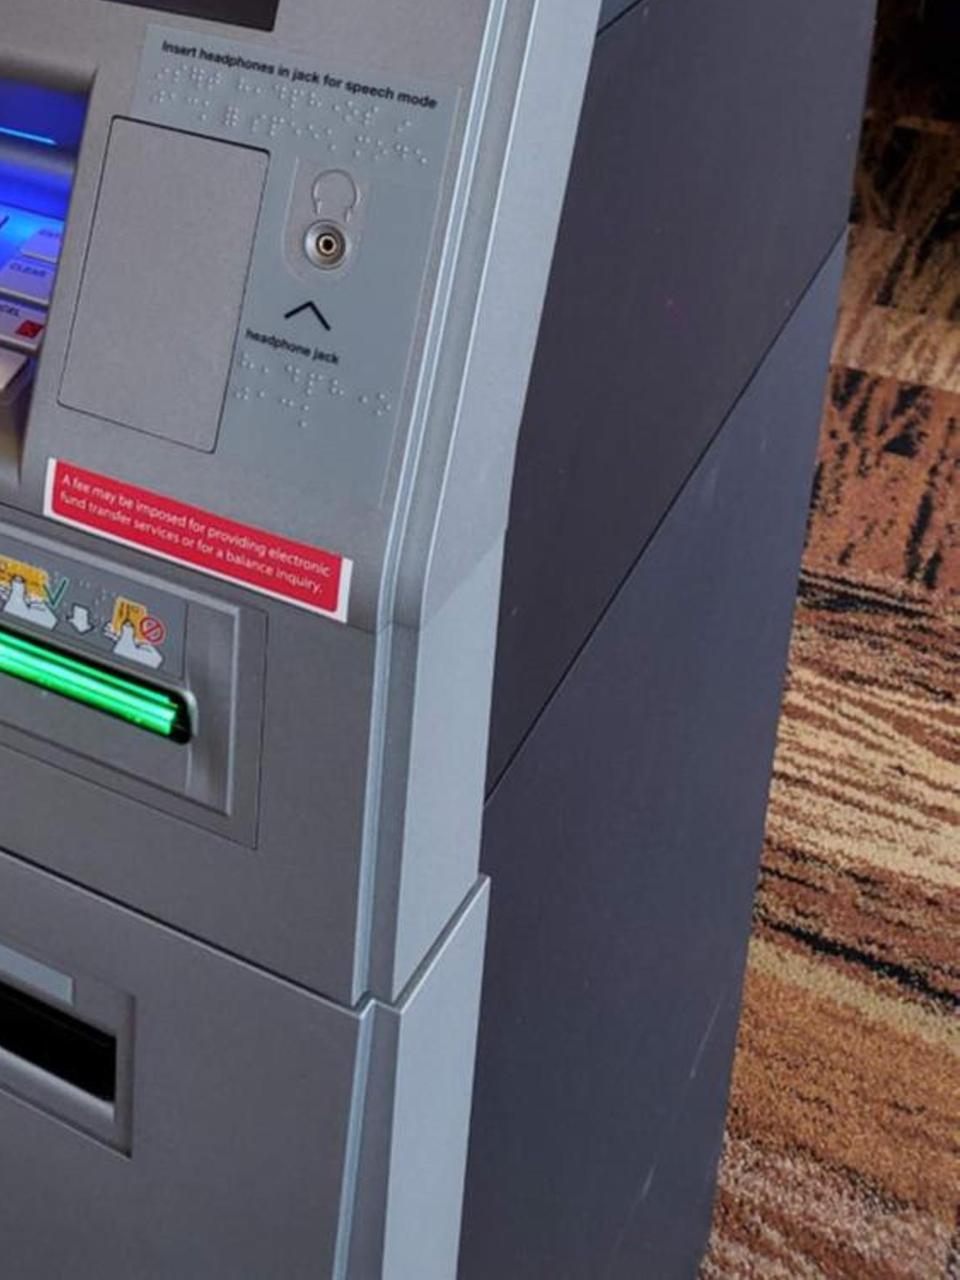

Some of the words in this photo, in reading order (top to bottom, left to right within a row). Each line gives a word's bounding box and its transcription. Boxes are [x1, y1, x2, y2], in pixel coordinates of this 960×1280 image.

[162, 39, 197, 59] Insert
[199, 47, 275, 75] headphones
[277, 64, 290, 77] in
[290, 68, 321, 84] jack
[323, 74, 344, 89] for
[344, 80, 395, 101] speech
[396, 92, 438, 110] mode
[245, 328, 312, 357] headphone
[311, 347, 339, 364] jack
[60, 491, 86, 510] fund
[87, 502, 132, 526] transfer
[133, 519, 180, 544] services
[181, 537, 195, 549] or
[196, 539, 214, 554] for
[225, 549, 275, 576] balance
[275, 567, 324, 595] inquiry.
[61, 474, 71, 487] A
[71, 477, 91, 494] fee
[91, 487, 117, 505] may
[118, 494, 135, 510] be
[136, 500, 187, 528] imposed
[187, 516, 206, 533] for
[206, 526, 268, 558] providing
[267, 547, 332, 578] electronic
